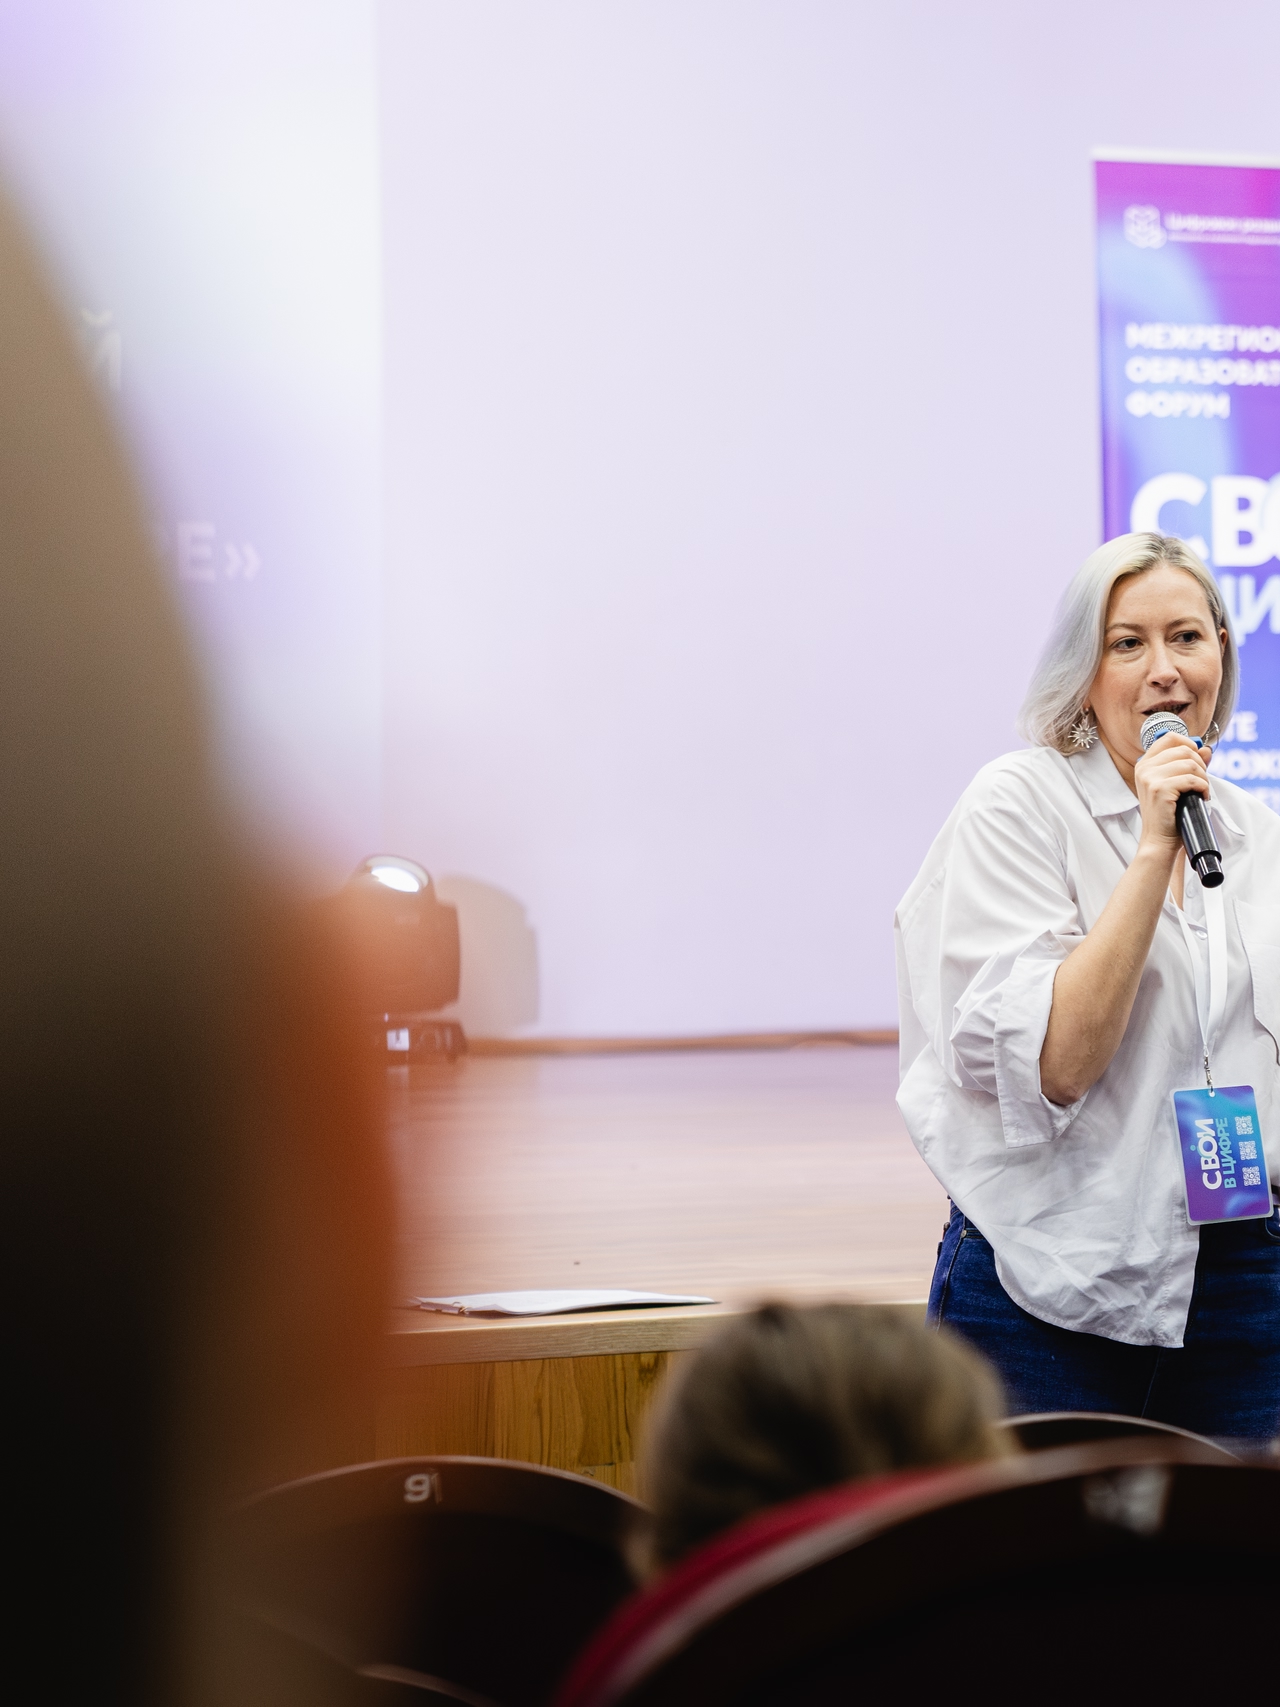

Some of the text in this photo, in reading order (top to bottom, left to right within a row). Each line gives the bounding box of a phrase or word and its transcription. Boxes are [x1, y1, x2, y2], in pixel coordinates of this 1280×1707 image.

[1193, 1118, 1223, 1190] СВОИ
[1215, 1117, 1238, 1189] В ЦИФРЕ
